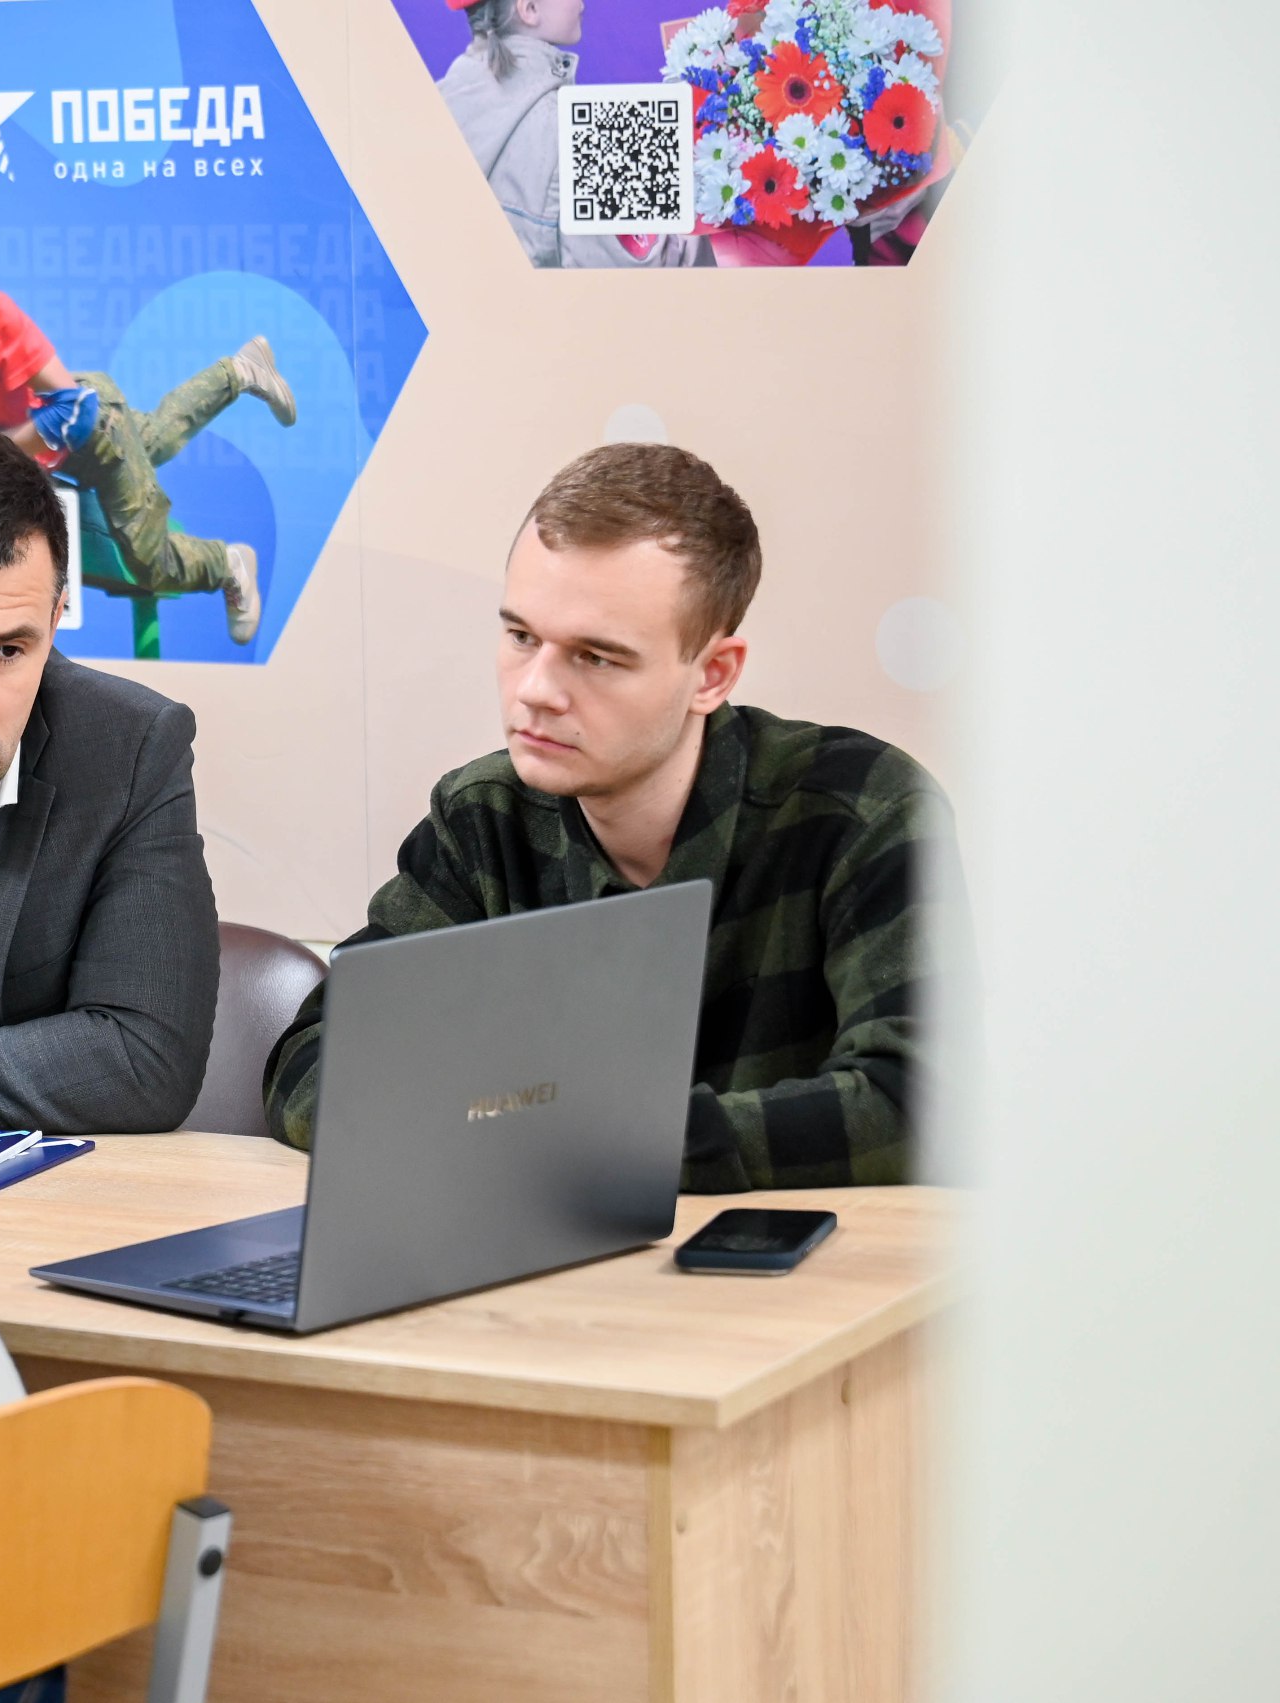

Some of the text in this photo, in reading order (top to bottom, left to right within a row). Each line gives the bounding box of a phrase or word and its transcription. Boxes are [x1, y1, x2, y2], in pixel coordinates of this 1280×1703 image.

[51, 85, 265, 147] ПОБЕДА
[54, 158, 264, 183] одна на всех
